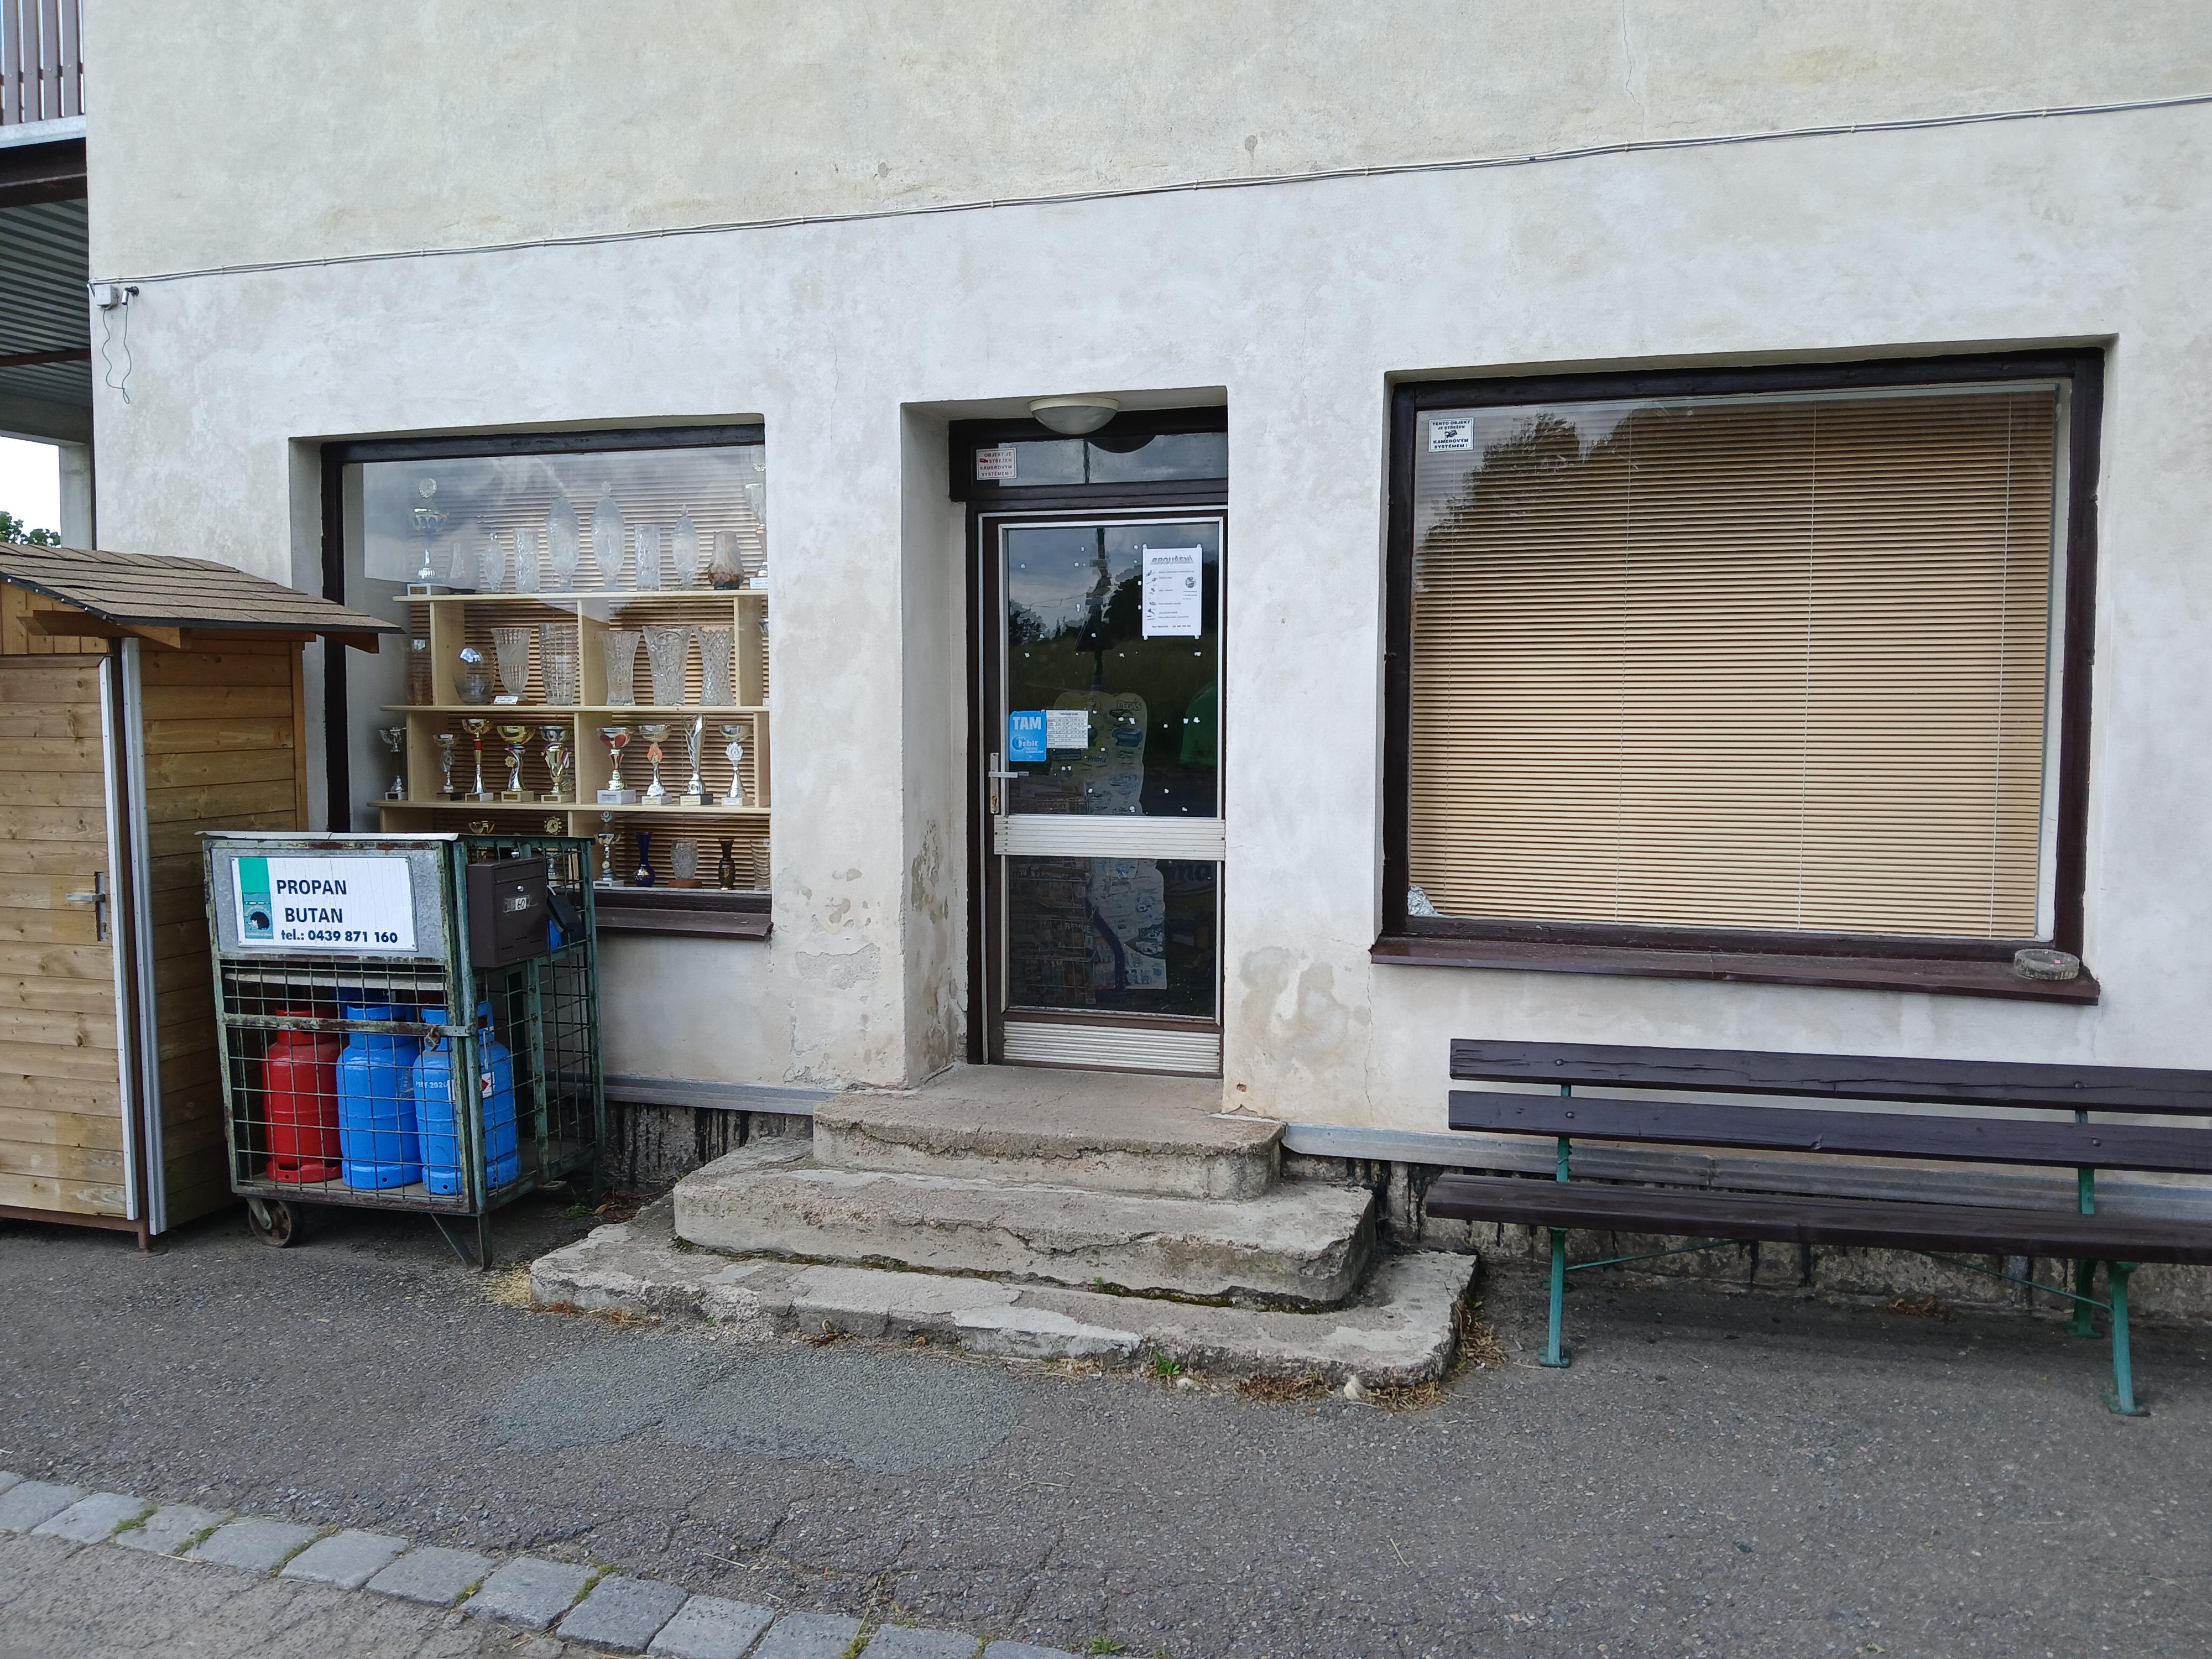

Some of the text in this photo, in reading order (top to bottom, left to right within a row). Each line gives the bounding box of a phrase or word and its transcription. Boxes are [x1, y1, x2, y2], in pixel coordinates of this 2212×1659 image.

[1150, 555, 1194, 565] BROUŠENÍ
[1013, 716, 1042, 730] TAM
[276, 879, 347, 895] PROPAN
[517, 899, 525, 909] 60
[285, 907, 343, 923] BUTAN
[281, 928, 304, 940] tel.:
[307, 930, 341, 941] 0439
[345, 931, 368, 942] 871
[374, 931, 398, 943] 160
